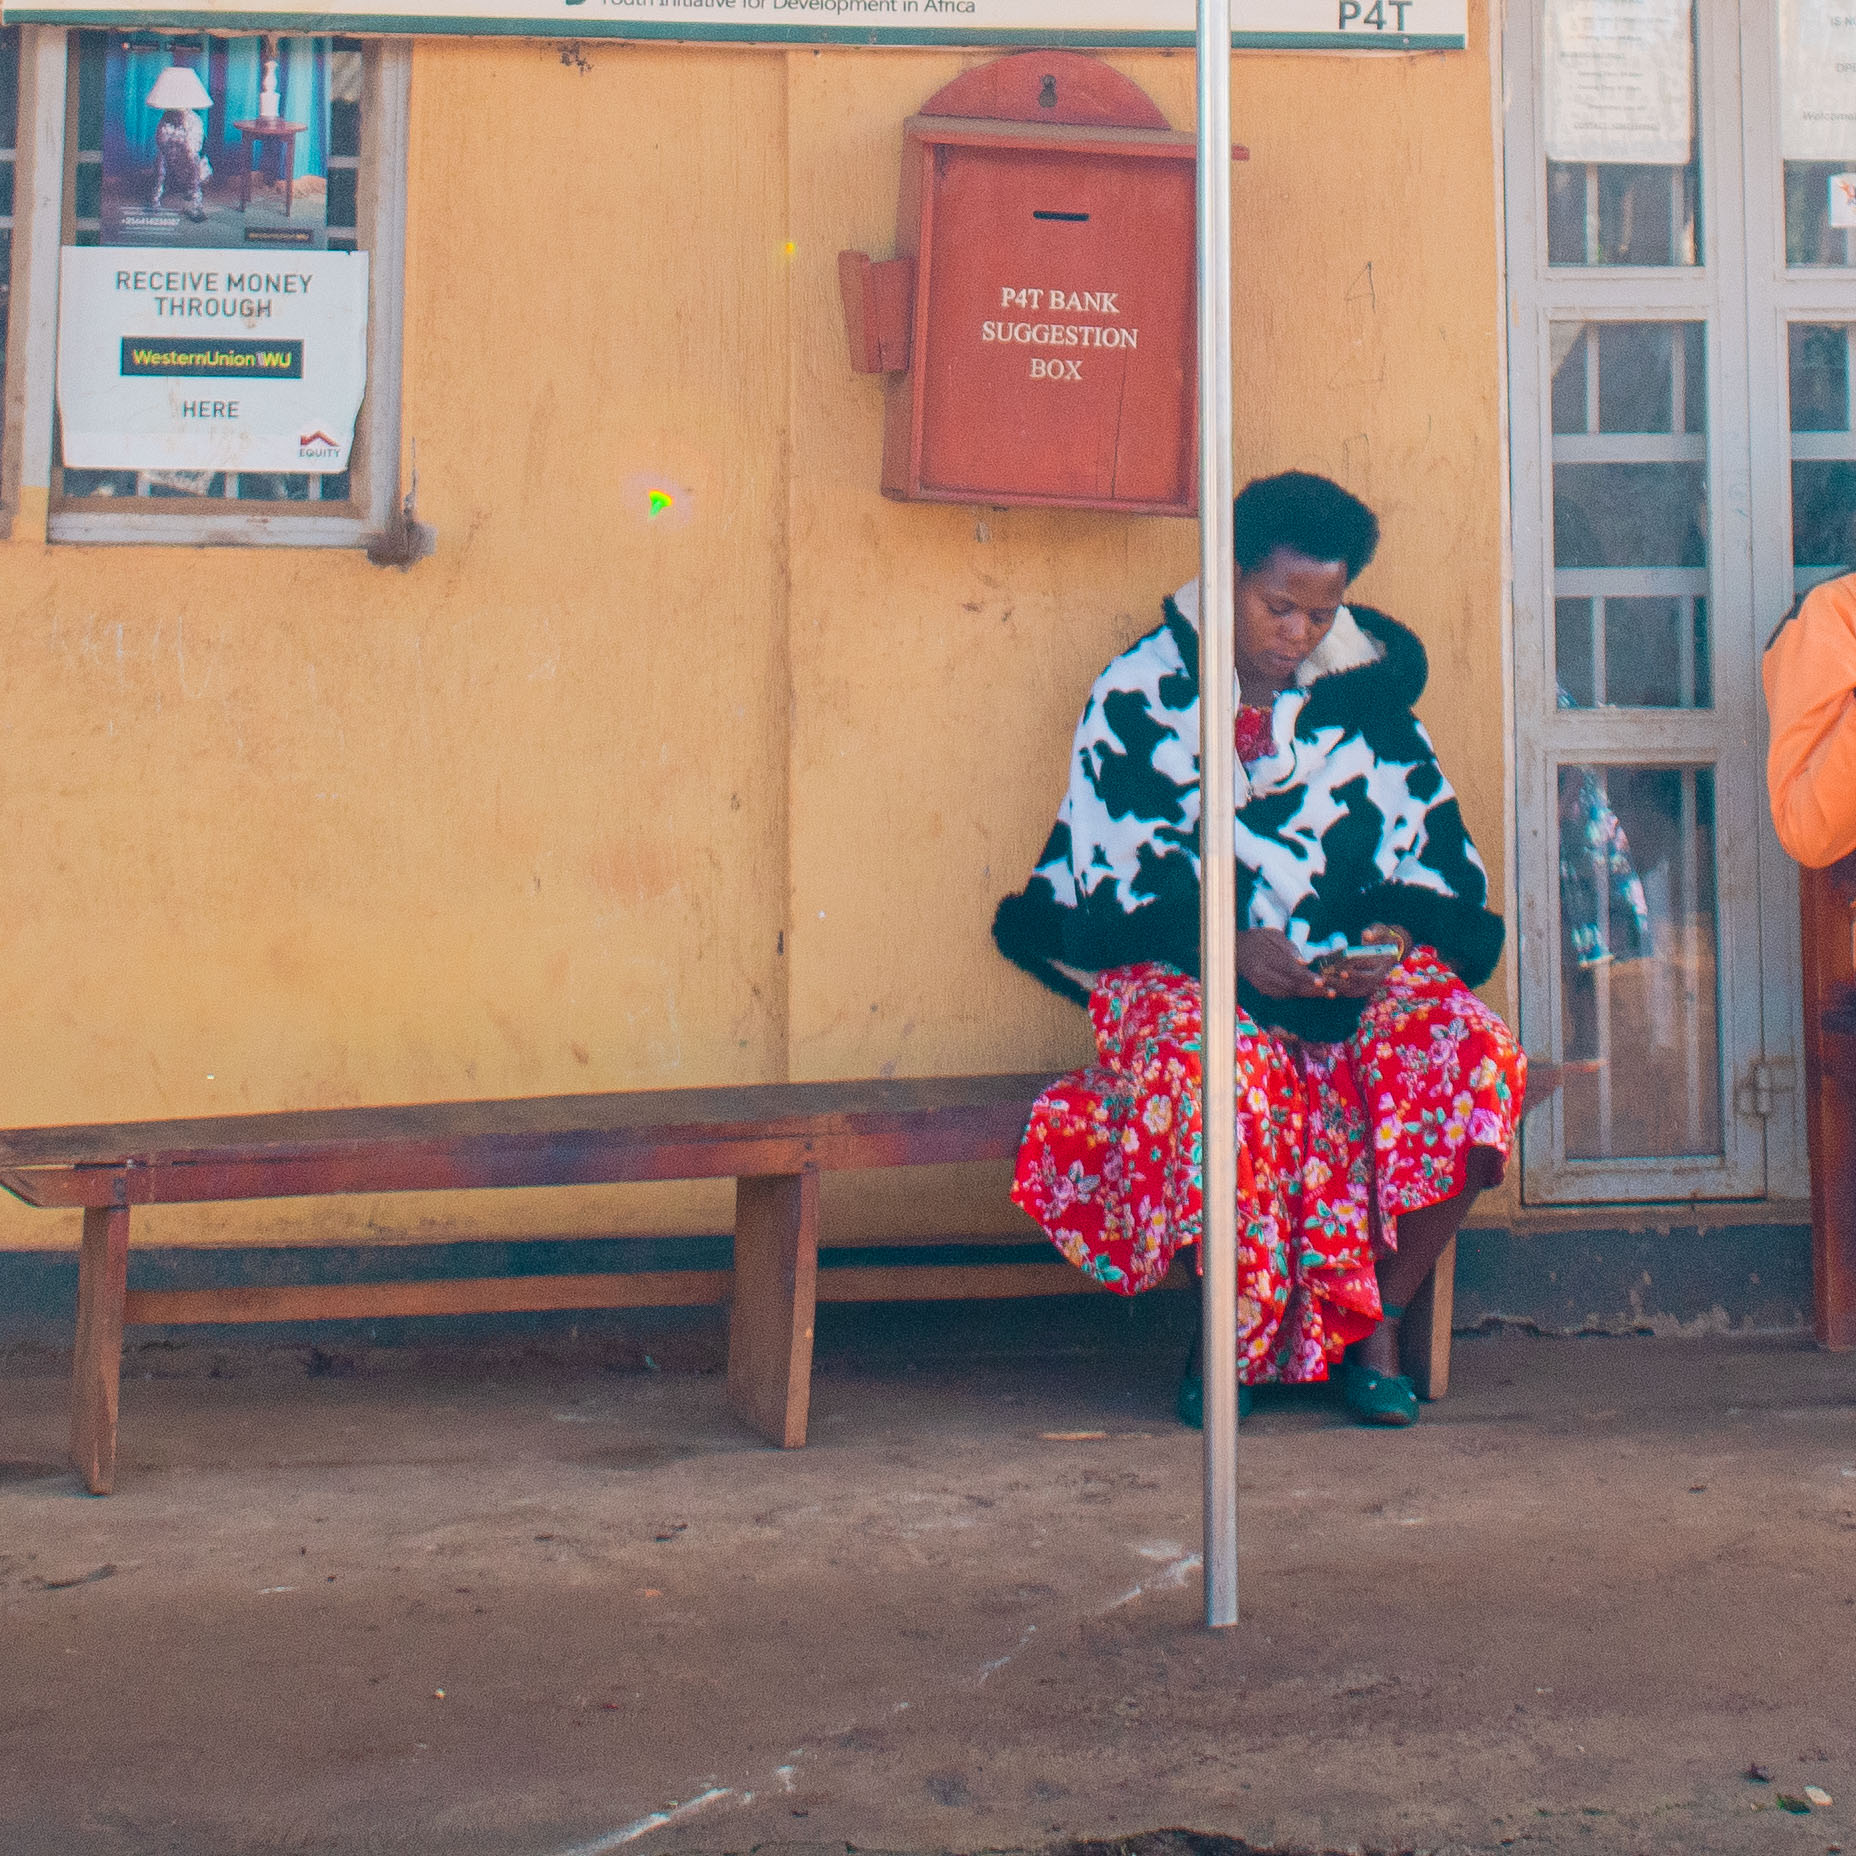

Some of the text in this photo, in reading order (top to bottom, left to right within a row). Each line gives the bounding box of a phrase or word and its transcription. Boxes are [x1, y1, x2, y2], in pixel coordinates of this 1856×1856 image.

[1336, 0, 1414, 33] P4T
[116, 271, 314, 295] RECEIVE MONEY
[154, 296, 274, 319] THROUGH
[1000, 286, 1121, 315] P4T BANK
[981, 320, 1139, 349] SUGGESTION
[132, 349, 256, 367] WesternUnion
[1029, 357, 1084, 381] BOX
[182, 400, 240, 419] HERE
[297, 448, 341, 459] EQUITY
